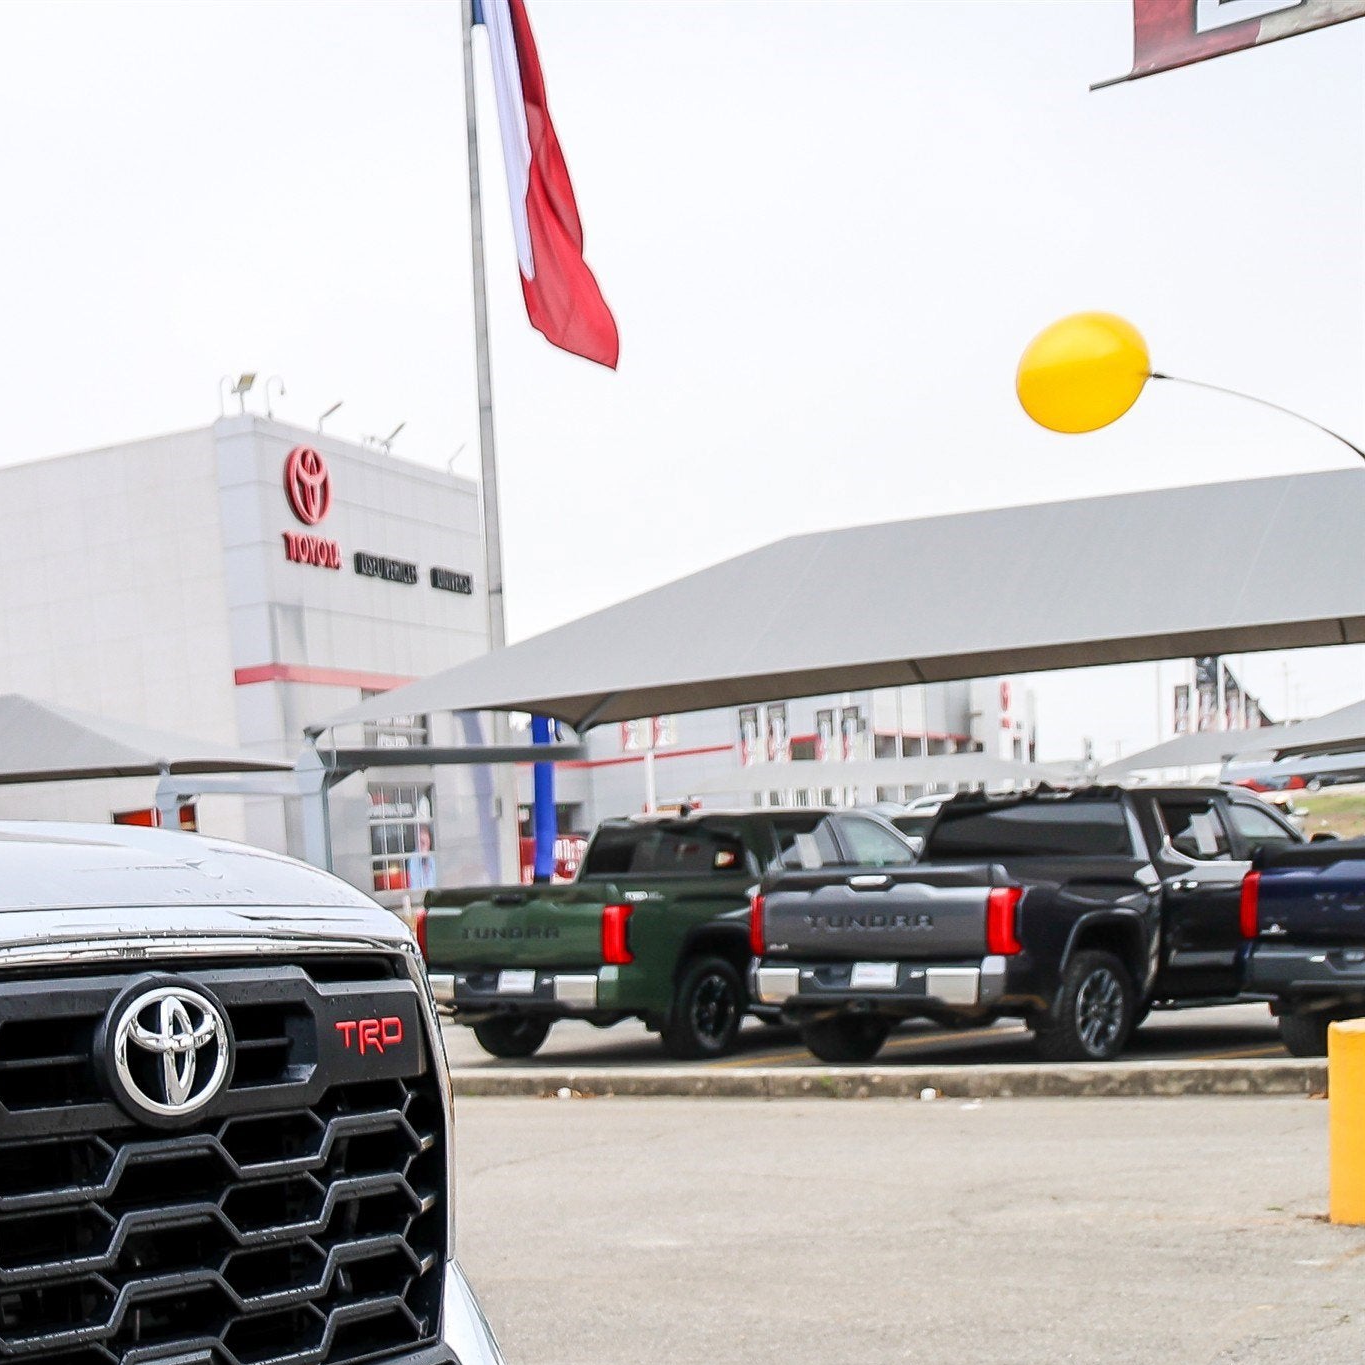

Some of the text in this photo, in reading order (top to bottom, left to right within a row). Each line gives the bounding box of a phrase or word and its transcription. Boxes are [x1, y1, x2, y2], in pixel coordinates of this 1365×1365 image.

[803, 915, 935, 932] TUNDRA
[461, 926, 561, 940] TUNDRA
[335, 1016, 404, 1056] TRD
